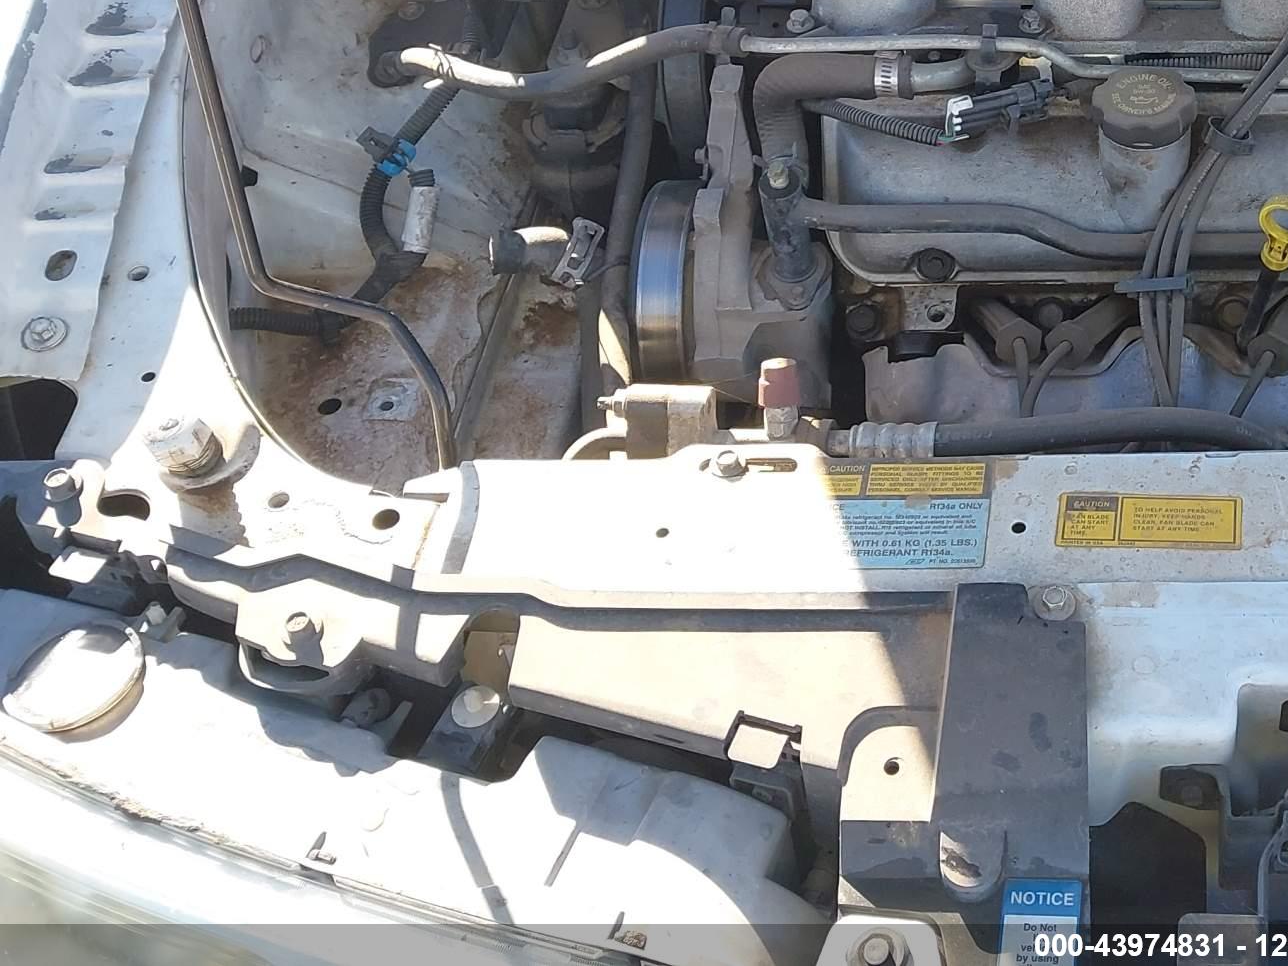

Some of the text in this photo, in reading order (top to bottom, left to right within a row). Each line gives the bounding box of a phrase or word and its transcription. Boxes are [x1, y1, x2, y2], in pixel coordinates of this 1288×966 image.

[1117, 73, 1173, 89] ENGINE OIL
[852, 539, 879, 547] WITH
[905, 539, 920, 547] KG
[924, 539, 947, 547] (1.35
[951, 539, 977, 547] LBS.)
[921, 549, 953, 557] R134a.
[1011, 891, 1074, 906] NOTICE
[1024, 923, 1037, 931] Do
[1016, 954, 1059, 964] by using
